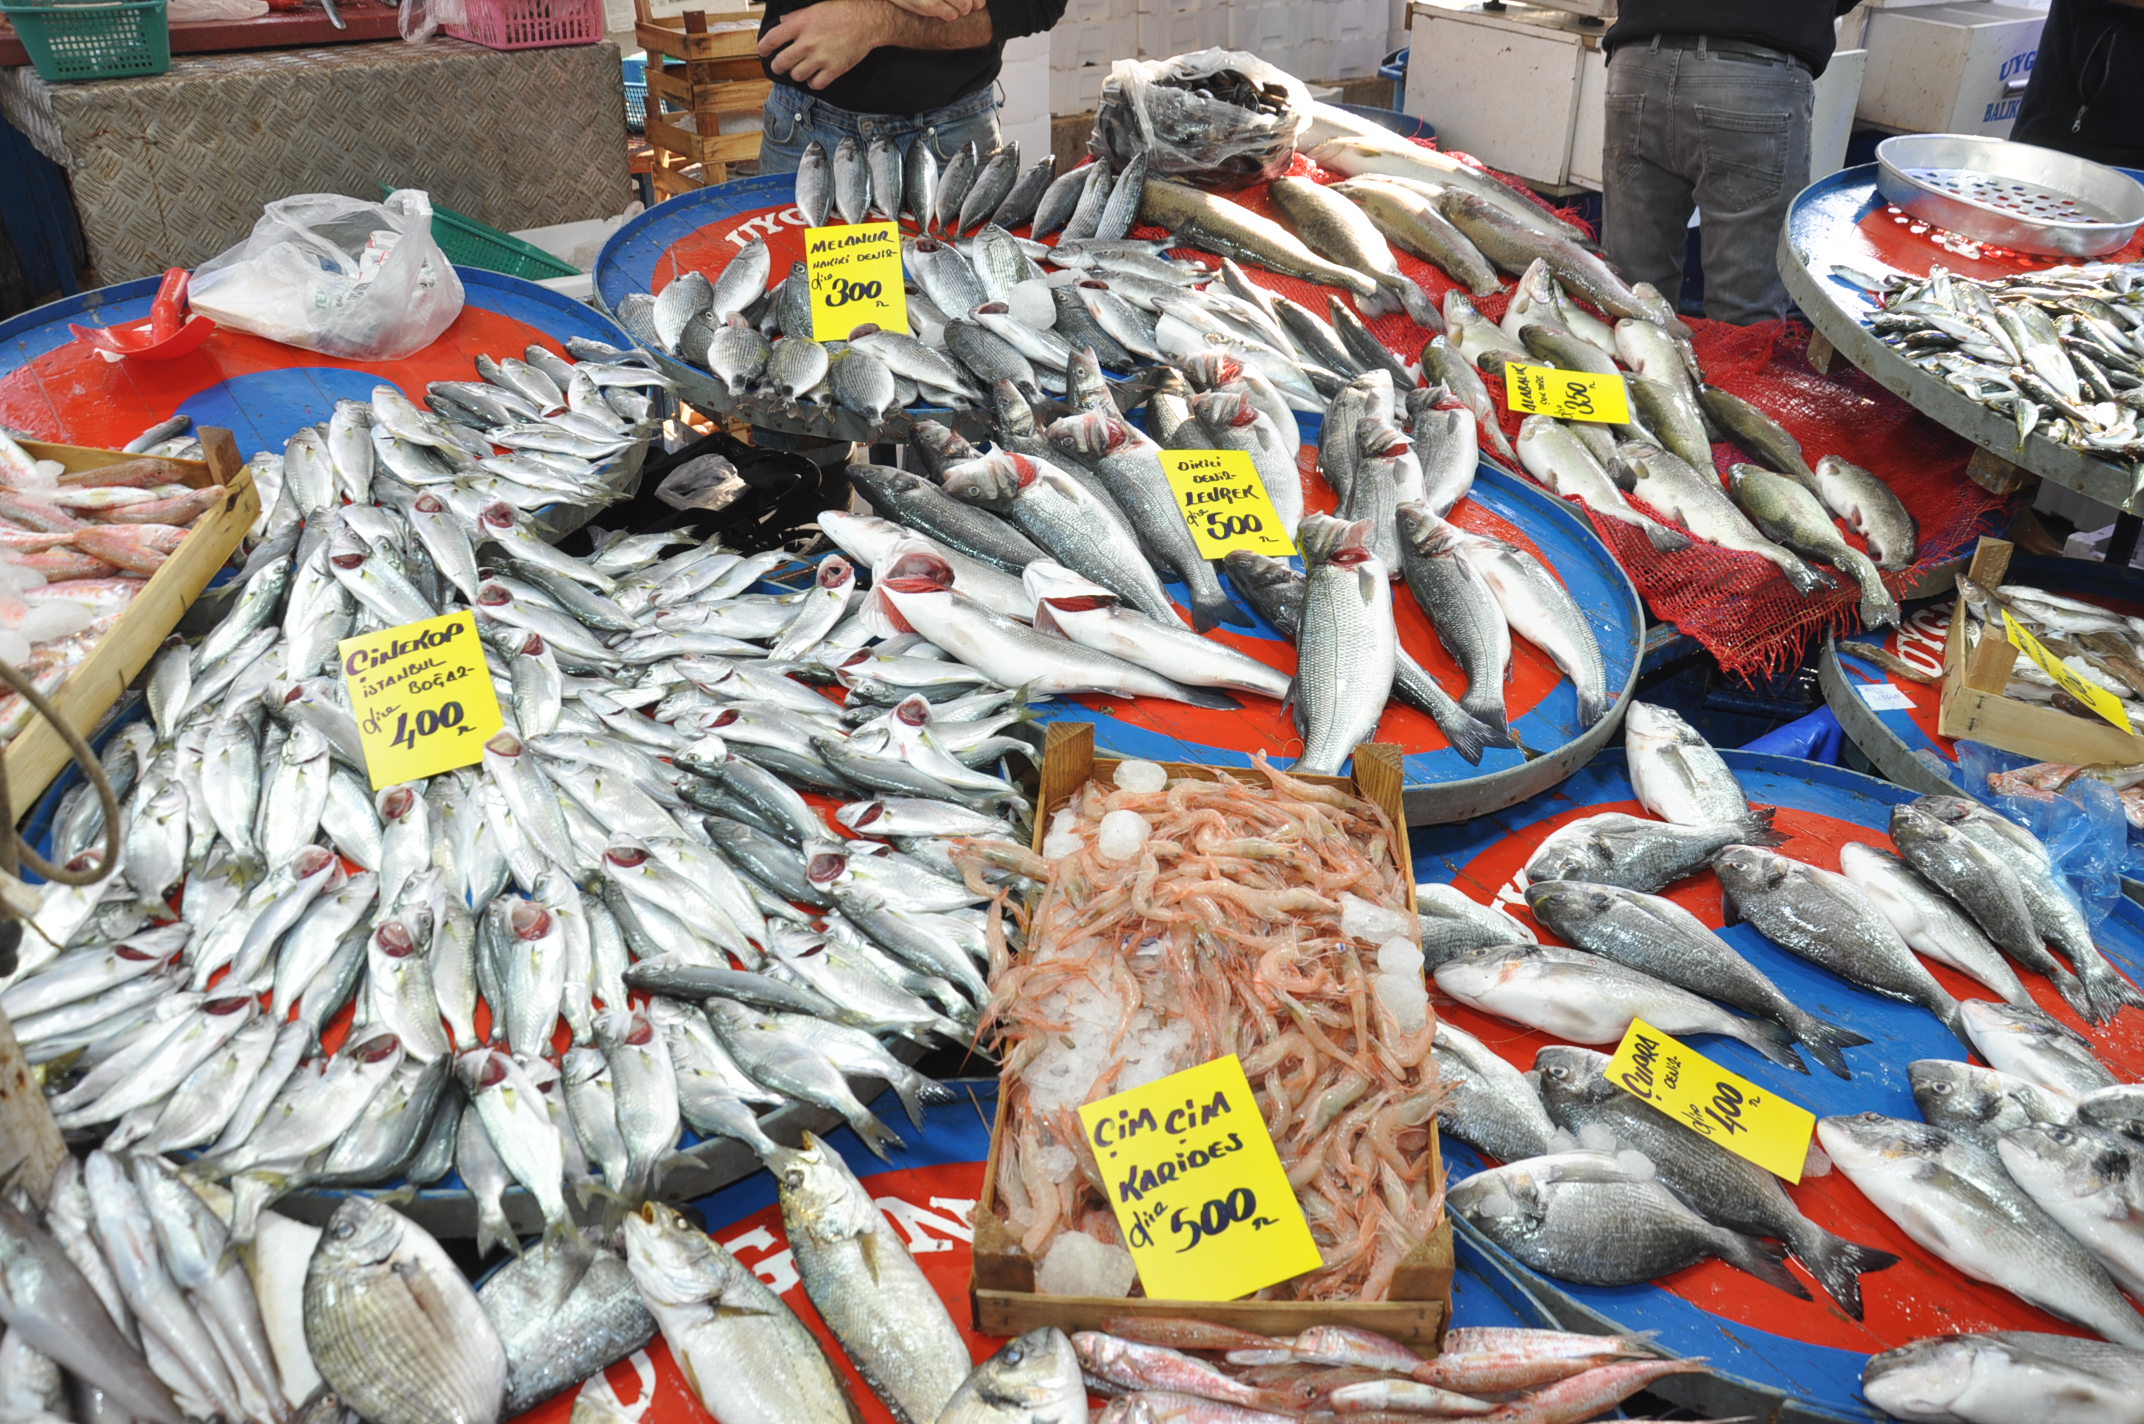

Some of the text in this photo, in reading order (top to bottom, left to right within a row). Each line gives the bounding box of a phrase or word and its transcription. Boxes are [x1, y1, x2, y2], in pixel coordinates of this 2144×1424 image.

[2000, 51, 2037, 82] UYG
[1983, 99, 2020, 123] BALIK
[725, 207, 812, 249] UYG
[825, 278, 882, 308] 300
[1564, 382, 1595, 415] 350
[1206, 511, 1263, 540] 500
[1896, 603, 1955, 678] UYG
[389, 700, 465, 750] 400
[1094, 1091, 1232, 1158] ÇİM ÇİM
[1704, 1081, 1748, 1135] 400
[1119, 1132, 1244, 1203] KARİDES
[1170, 1187, 1257, 1253] 500
